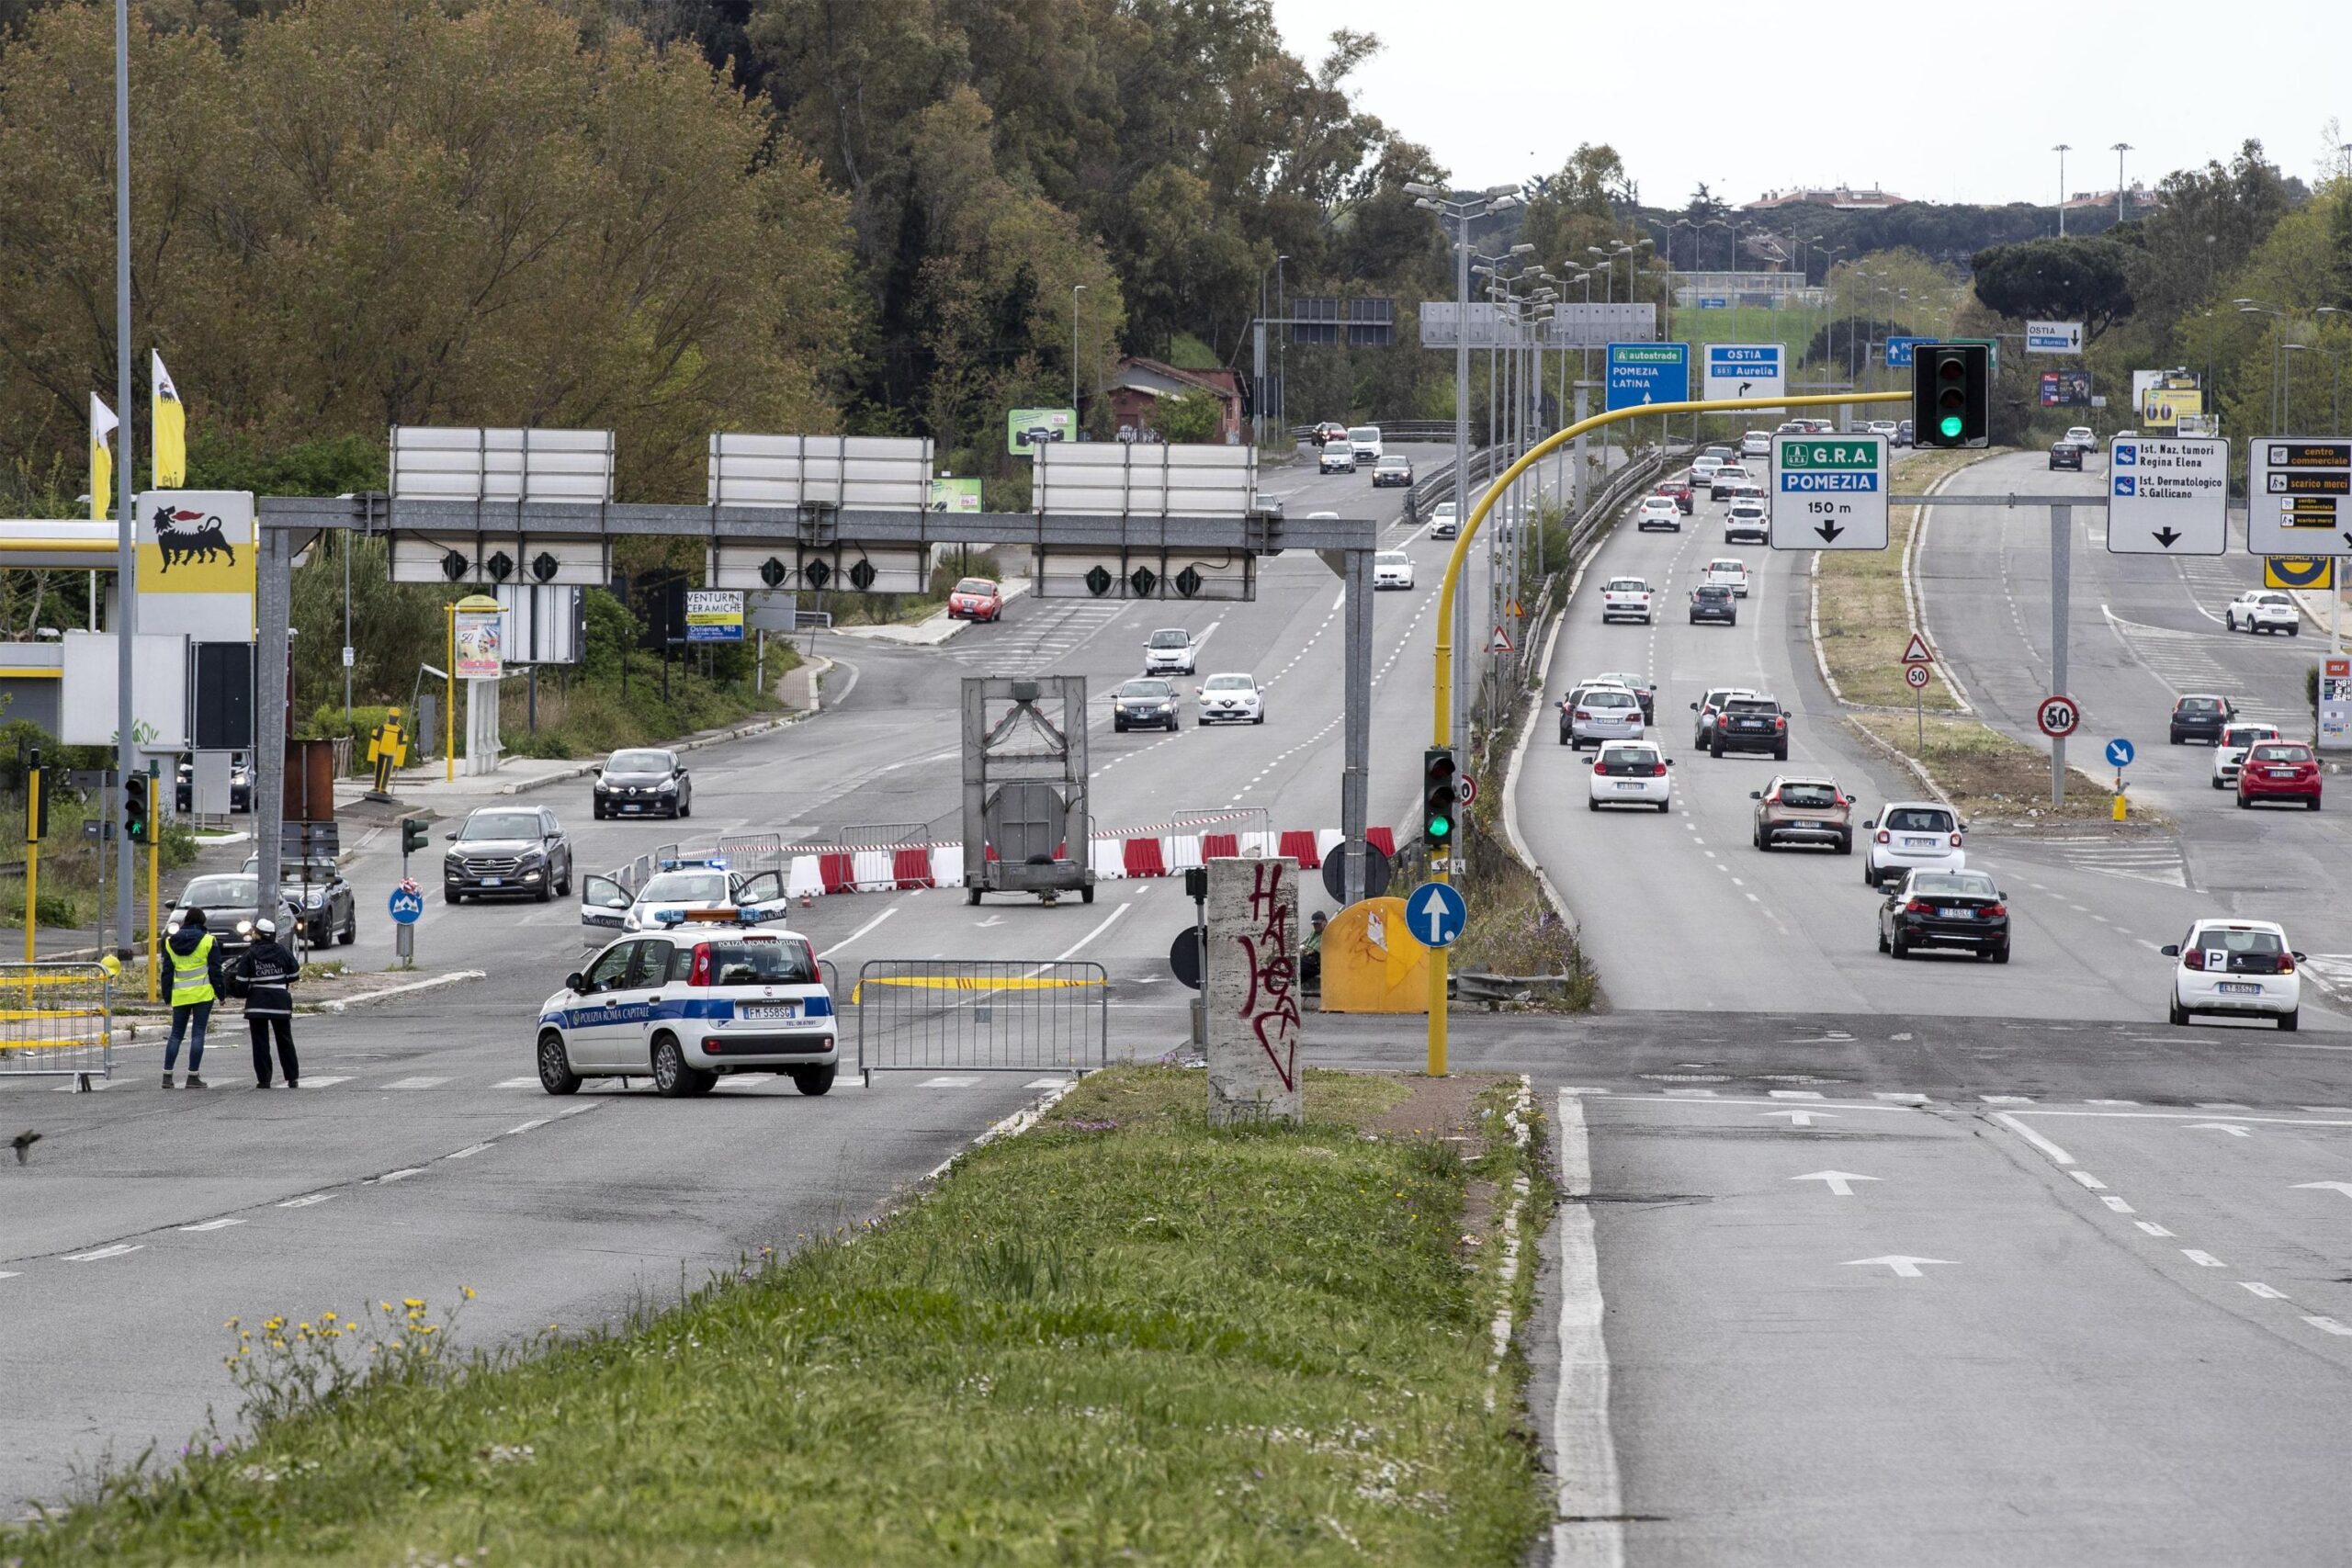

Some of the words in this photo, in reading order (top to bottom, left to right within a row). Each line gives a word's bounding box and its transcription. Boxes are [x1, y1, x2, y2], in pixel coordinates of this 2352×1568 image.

[2030, 326, 2055, 334] OSTIA
[1629, 352, 1678, 360] autostrade
[1727, 350, 1761, 359] OSTIA
[1613, 367, 1659, 376] POMEZIA
[1736, 367, 1774, 376] Aurelia
[1612, 379, 1651, 388] LATINA
[1813, 447, 1873, 463] G.R.A.
[2140, 444, 2157, 455] Ist.
[2160, 445, 2179, 455] Naz.
[2182, 445, 2214, 456] tumori
[2140, 457, 2173, 468] Regina
[2176, 457, 2202, 468] Elena
[2291, 457, 2348, 465] commerciale
[1787, 474, 1871, 490] POMEZIA
[2139, 476, 2155, 486] Ist.
[2157, 476, 2222, 489] Dermatologico
[2290, 479, 2322, 489] scarico
[2324, 479, 2348, 489] merci
[2139, 488, 2148, 498] S.
[2149, 488, 2192, 499] Gallicano
[1808, 502, 1834, 513] 150
[1839, 505, 1851, 513] m
[687, 592, 742, 603] VENTURINI
[687, 604, 742, 613] CERAMICHE
[1911, 671, 1925, 682] 50
[2046, 707, 2069, 728] 50
[1462, 783, 1470, 798] 0
[601, 918, 625, 927] CAPITAL
[2209, 953, 2223, 966] P
[255, 962, 276, 970] ROMA
[580, 1012, 602, 1023] POLIZIA
[603, 1010, 621, 1021] ROMA
[623, 1006, 650, 1019] CAPITALE
[749, 1007, 761, 1018] FM
[763, 1006, 791, 1018] 558SG
